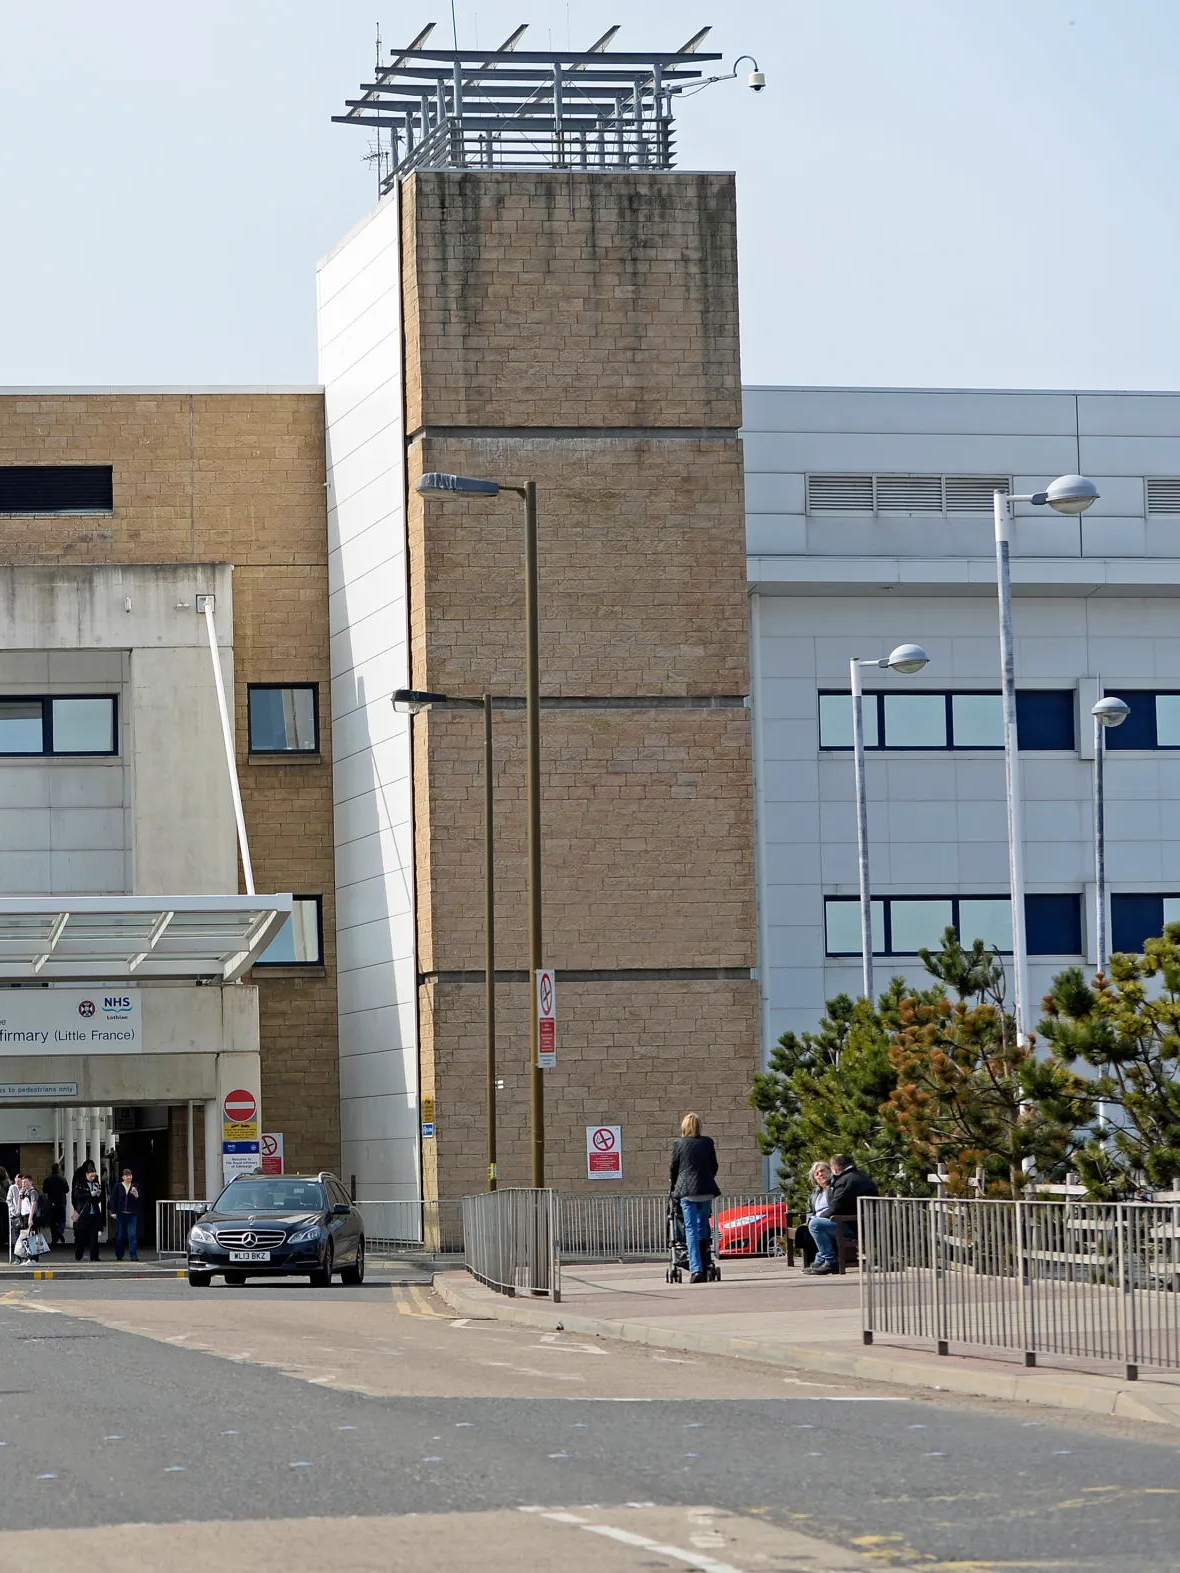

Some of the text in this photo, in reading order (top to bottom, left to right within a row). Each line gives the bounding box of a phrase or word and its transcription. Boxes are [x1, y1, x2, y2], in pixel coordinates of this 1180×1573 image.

[104, 997, 130, 1007] NHS
[54, 1029, 86, 1042] (Little
[91, 1028, 135, 1041] France)
